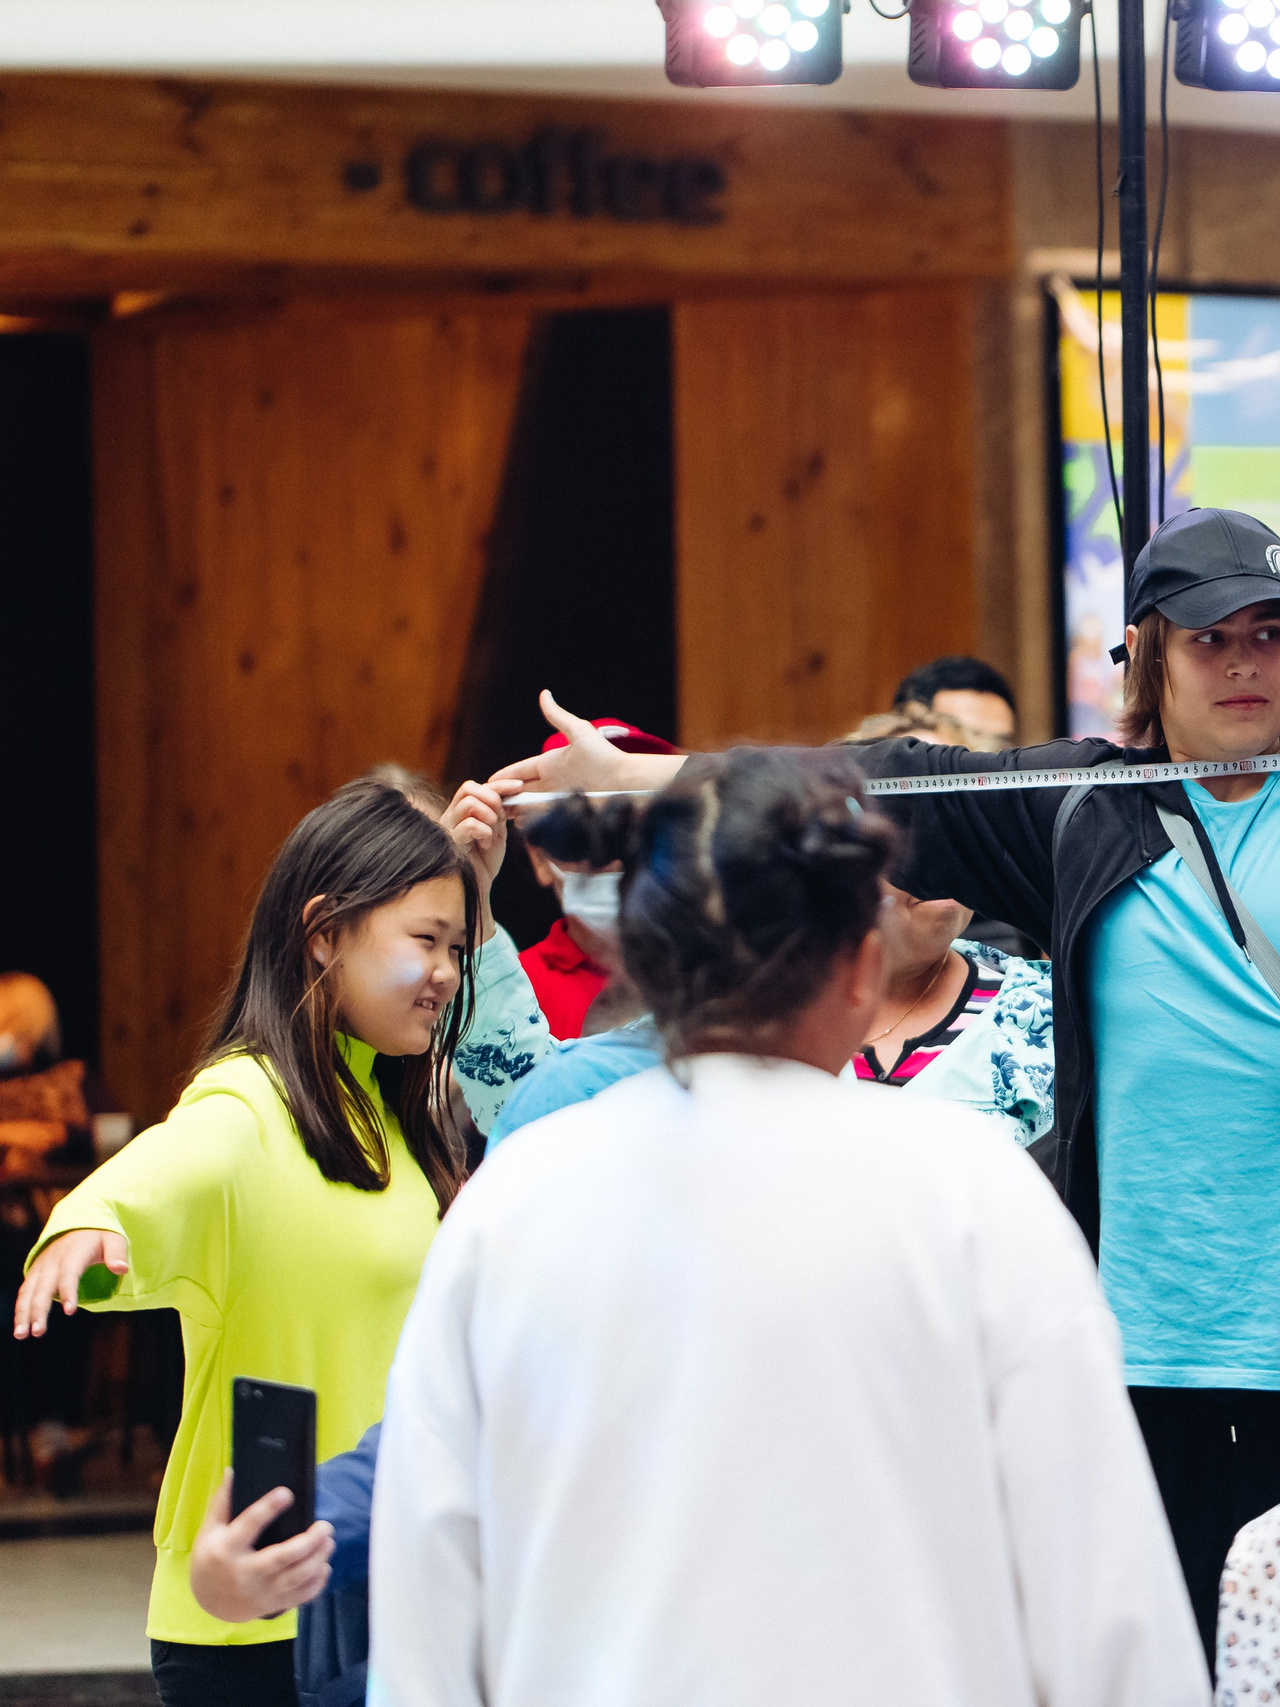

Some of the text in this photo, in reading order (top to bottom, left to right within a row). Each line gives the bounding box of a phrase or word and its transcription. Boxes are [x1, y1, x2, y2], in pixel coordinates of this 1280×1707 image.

[405, 121, 728, 228] coffee
[1143, 769, 1154, 779] 90
[1239, 760, 1252, 771] 100
